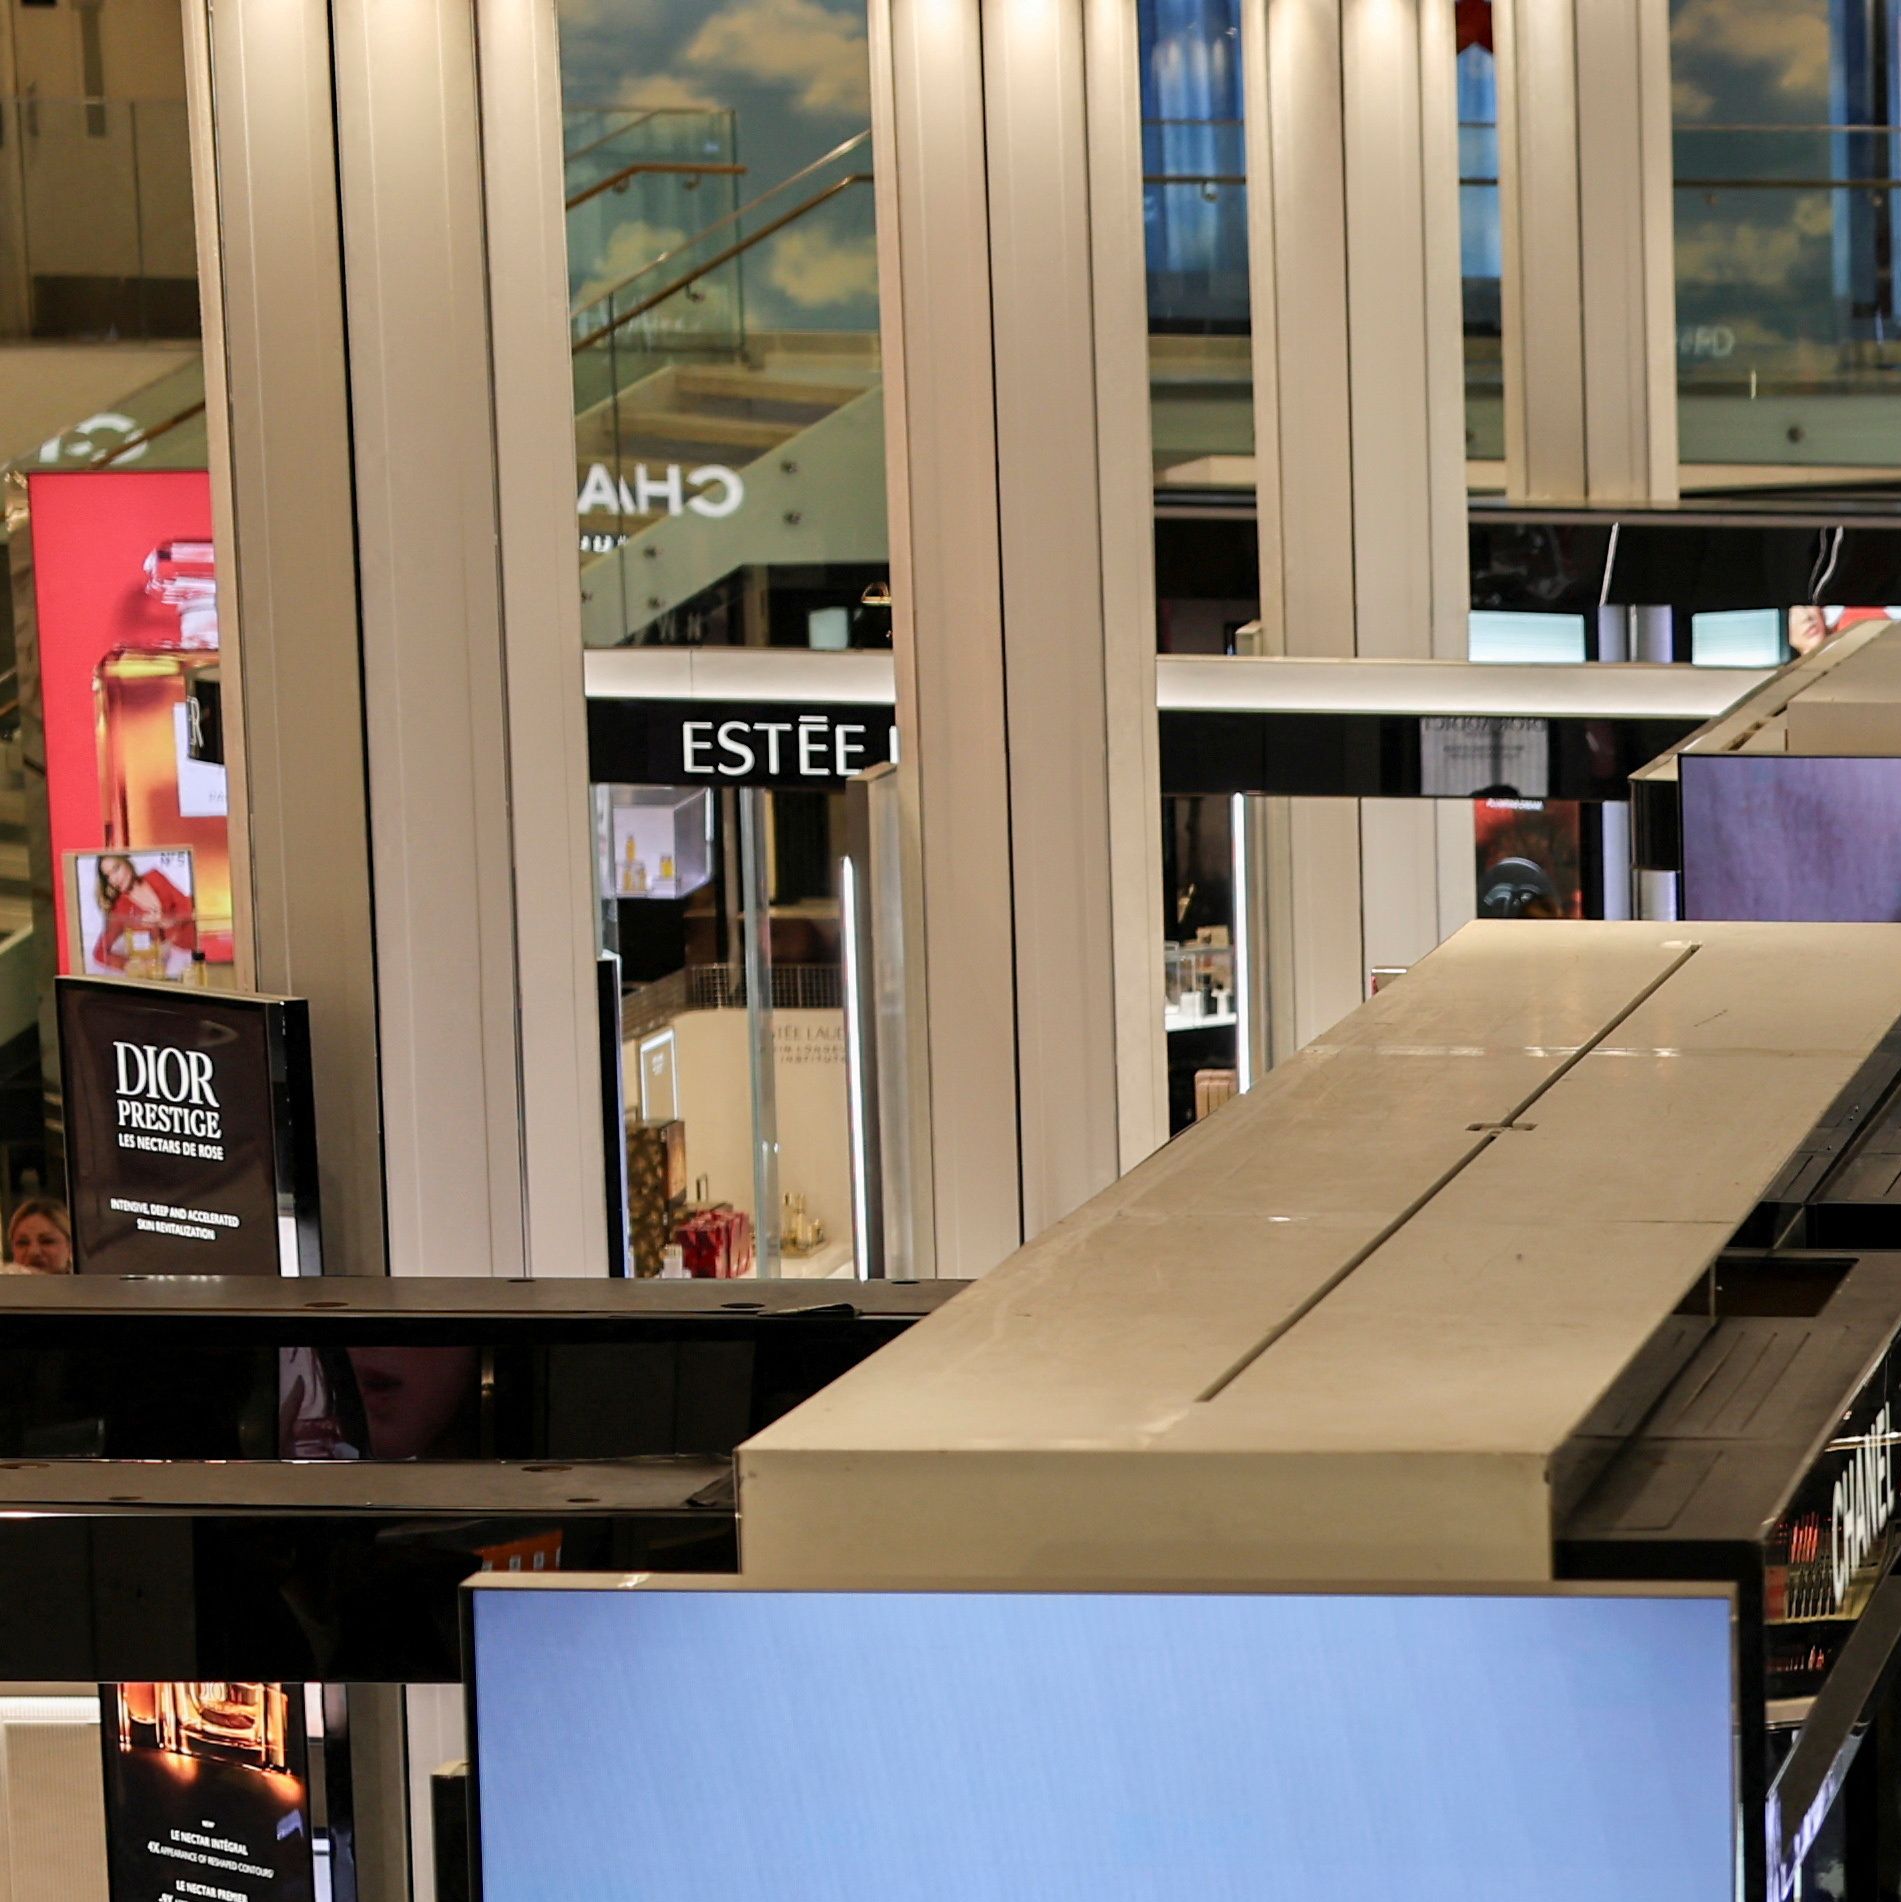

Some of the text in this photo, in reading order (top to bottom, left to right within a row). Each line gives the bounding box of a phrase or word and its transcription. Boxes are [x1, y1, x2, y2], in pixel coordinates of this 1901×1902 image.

[112, 1040, 221, 1108] DIOR
[116, 1099, 223, 1140] PRESTIGE
[118, 1132, 225, 1161] LES NECTARS DE ROSE
[136, 1217, 216, 1241] SKIN REVITALIZATION
[150, 1203, 169, 1217] DEEP
[169, 1206, 188, 1220] AND
[187, 1208, 240, 1228] ACCELERATED
[1831, 1400, 1895, 1608] CHANEL
[170, 1828, 249, 1857] LE NECTAR INTÉGRAL
[175, 1879, 186, 1892] LE
[186, 1882, 217, 1898] NECTAR
